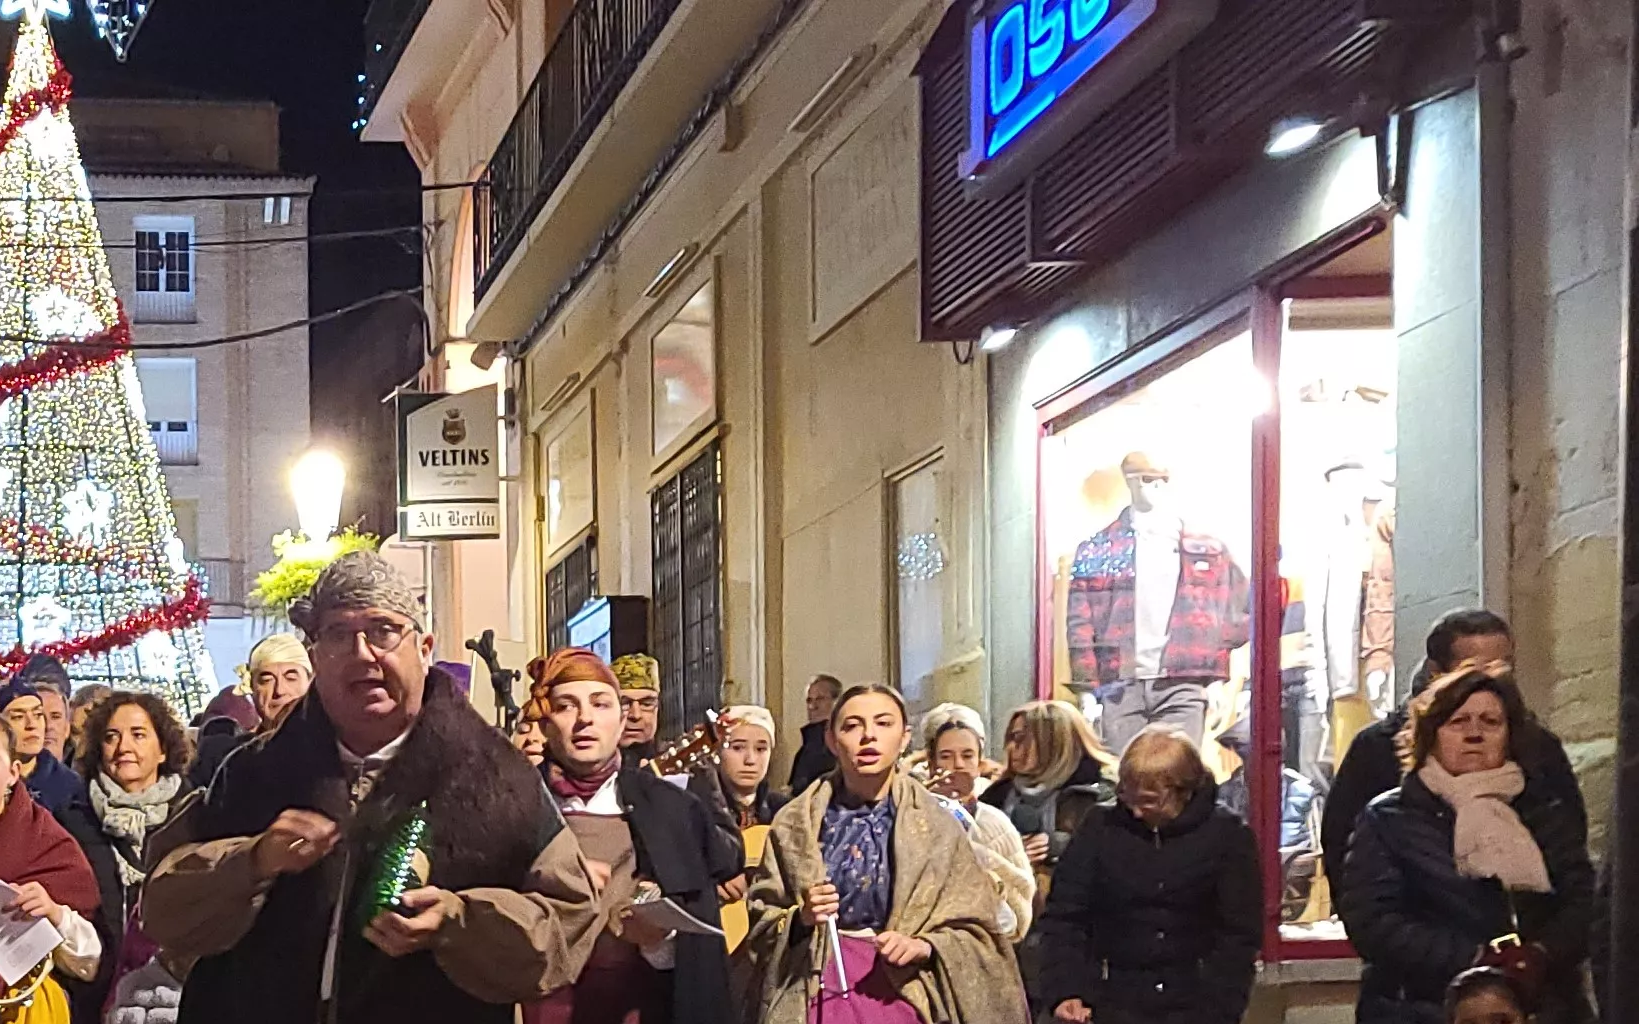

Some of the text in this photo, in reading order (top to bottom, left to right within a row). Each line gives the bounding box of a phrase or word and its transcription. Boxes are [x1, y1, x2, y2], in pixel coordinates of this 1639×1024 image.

[418, 448, 490, 467] VELTINS
[416, 510, 495, 528] Alt Berlin
